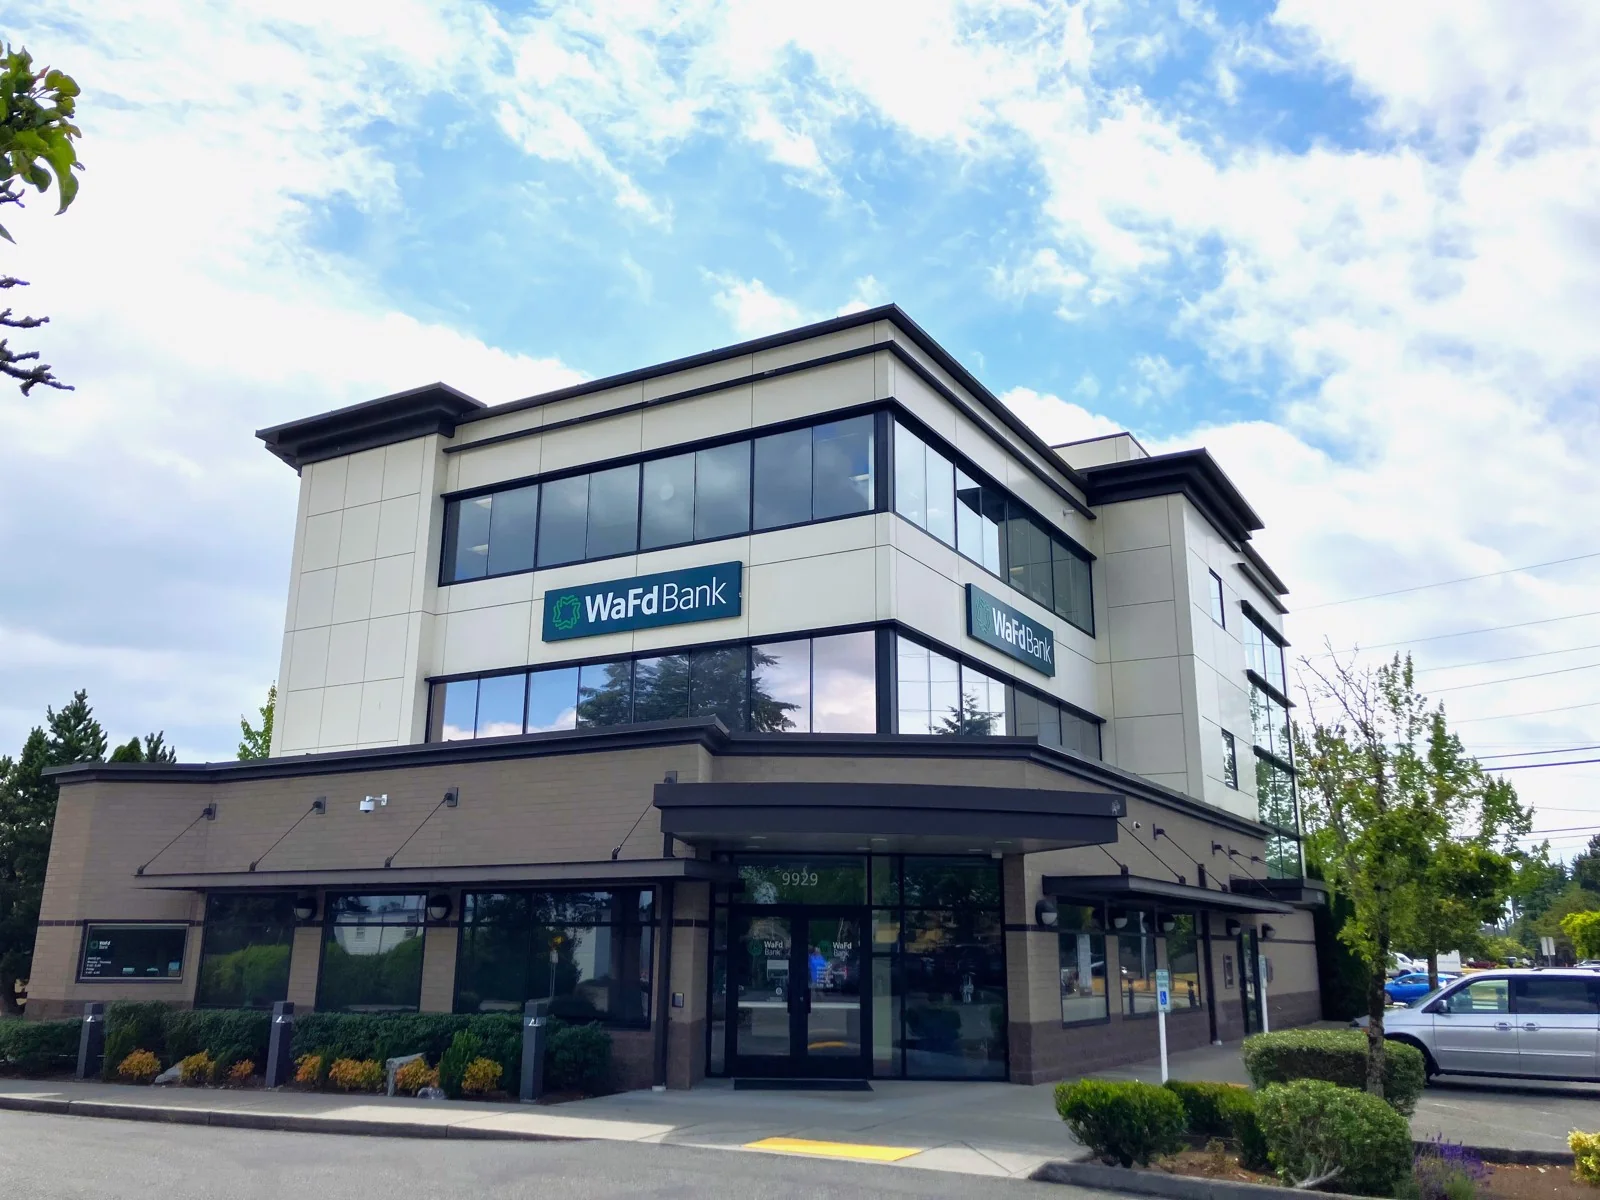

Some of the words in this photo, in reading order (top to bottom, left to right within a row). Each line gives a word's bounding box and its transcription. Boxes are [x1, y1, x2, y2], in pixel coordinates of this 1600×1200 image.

[585, 585, 659, 624] WaFd
[662, 576, 727, 613] Bank
[992, 607, 1026, 651] WaFd
[1026, 626, 1052, 665] Bank
[782, 872, 818, 886] 9929
[764, 940, 783, 949] WaFd
[832, 941, 852, 950] WaFd
[764, 948, 781, 956] Bank
